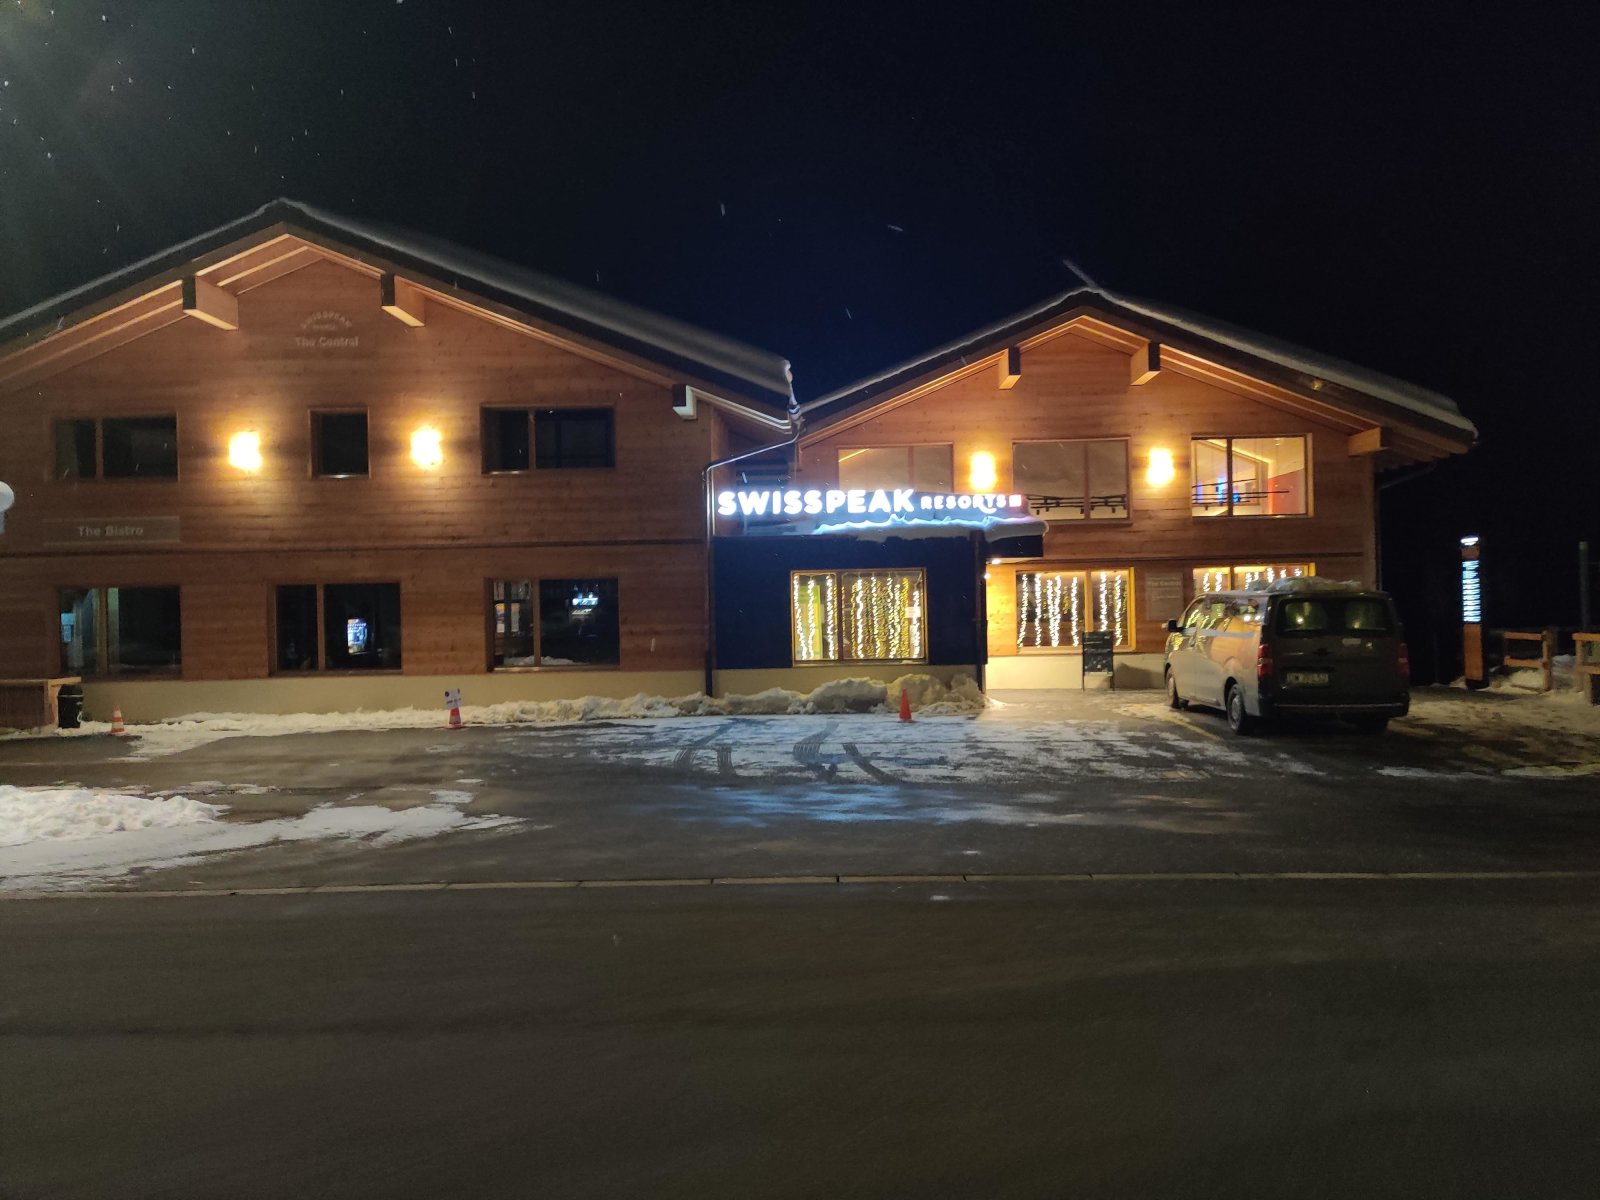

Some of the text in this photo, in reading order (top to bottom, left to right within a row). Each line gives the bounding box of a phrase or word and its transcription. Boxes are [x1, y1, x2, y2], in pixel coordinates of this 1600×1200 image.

[319, 335, 359, 347] Central
[717, 488, 1007, 517] SWISSPEAK RESORTS
[77, 525, 144, 537] The Bistro
